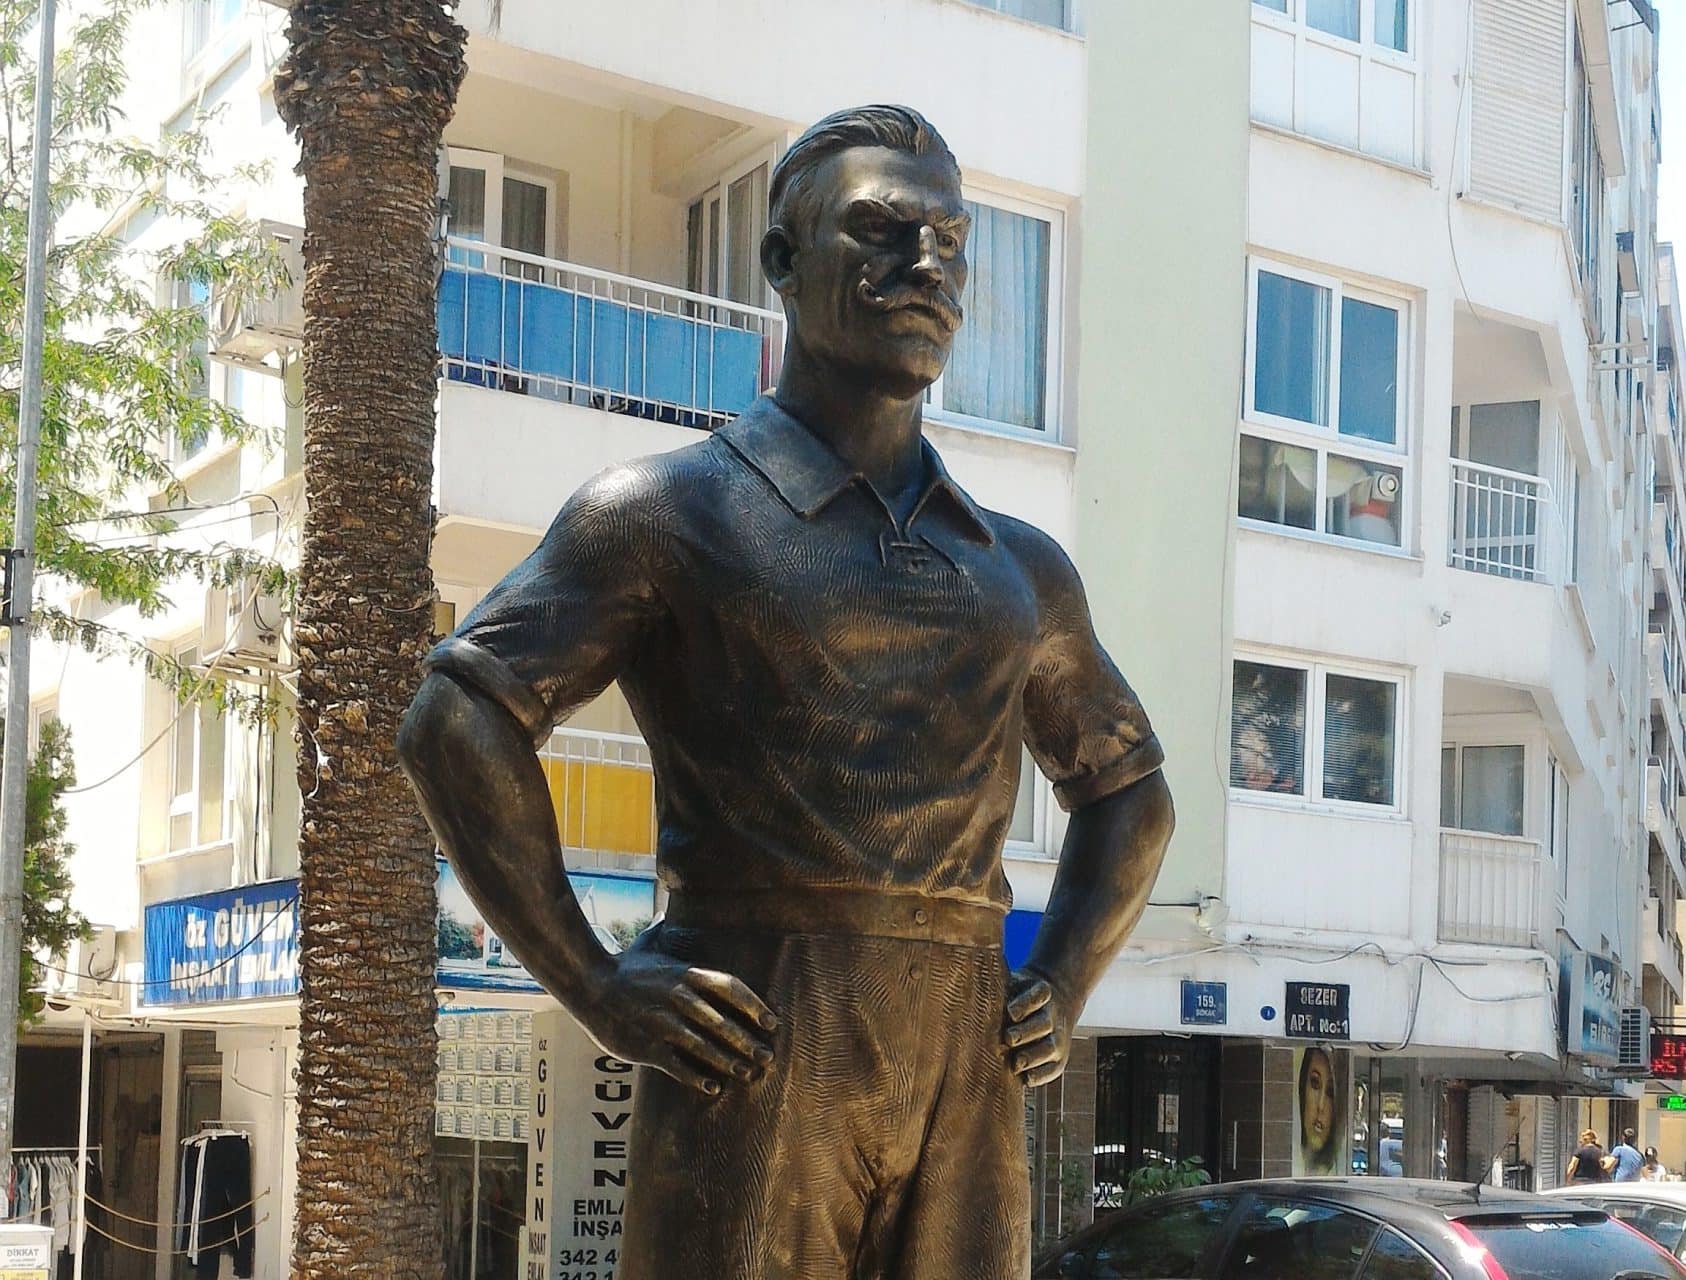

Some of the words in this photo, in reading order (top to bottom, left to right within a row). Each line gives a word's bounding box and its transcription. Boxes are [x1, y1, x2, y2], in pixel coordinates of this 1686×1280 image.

[214, 898, 295, 948] GÜVEN
[170, 957, 235, 994] İNŞAAT
[1300, 987, 1339, 1006] SEZER
[1290, 1014, 1315, 1033] APT.
[591, 1055, 633, 1187] GÜVEN
[535, 1059, 547, 1222] GÜVEN
[560, 1249, 598, 1266] 342
[604, 1248, 621, 1265] 4
